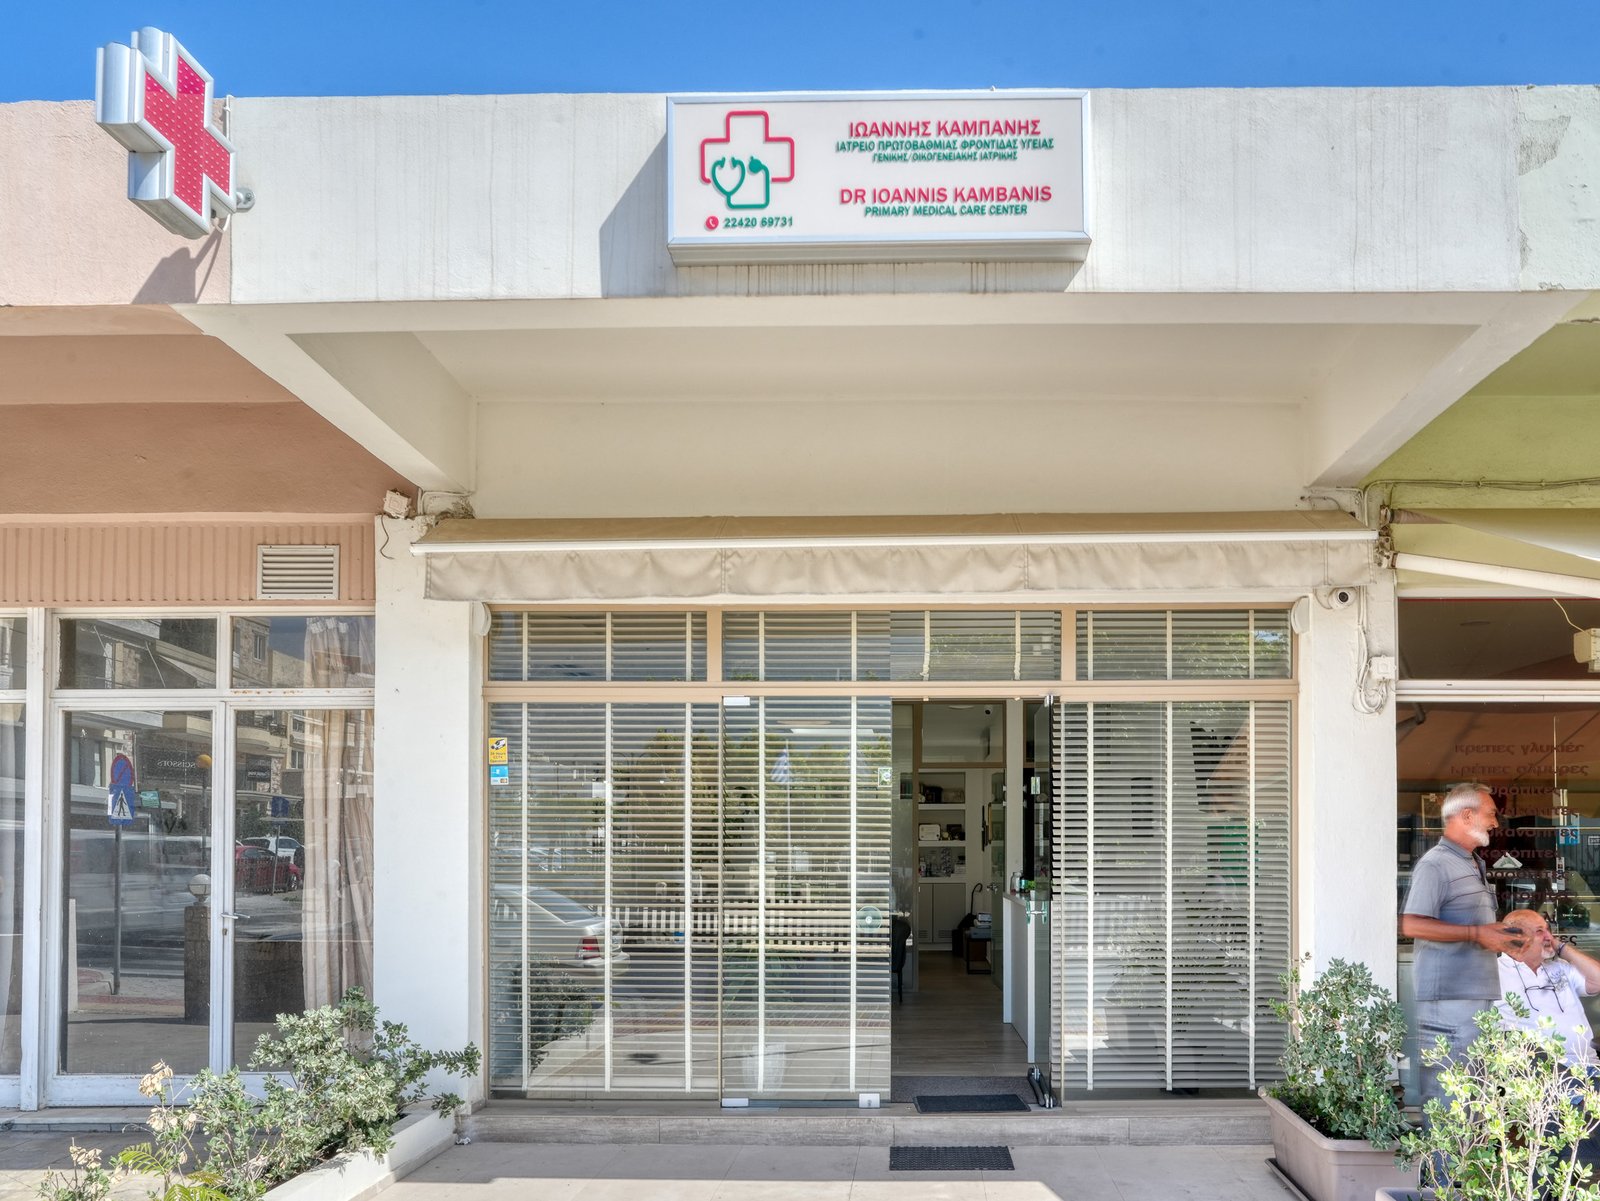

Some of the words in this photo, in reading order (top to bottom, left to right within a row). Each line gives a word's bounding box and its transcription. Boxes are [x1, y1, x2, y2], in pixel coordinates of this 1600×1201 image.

[849, 120, 932, 138] ΙΩΑΝΝΗΣ
[936, 119, 1041, 136] ΚΑΜΠΑΝΗΣ
[836, 141, 876, 152] ΙΑΤΡΕΙΟ
[877, 139, 958, 151] ΠΡΩΤΟΒΑΘΜΙΑΣ
[960, 138, 1018, 150] ΦΡΟΝΤΙΔΑΣ
[1021, 137, 1054, 149] ΥΓΕΙΑΣ
[979, 150, 1018, 161] ΙΑΤΡΙΚΗΣ
[840, 188, 867, 204] DR
[872, 187, 949, 204] IOANNIS
[953, 185, 1052, 203] KAMBANIS
[865, 206, 910, 217] PRIMARY
[912, 205, 958, 216] MEDICAL
[959, 204, 987, 215] CARE
[989, 203, 1028, 215] CENTER
[724, 216, 758, 228] 22420
[760, 215, 794, 227] 69731
